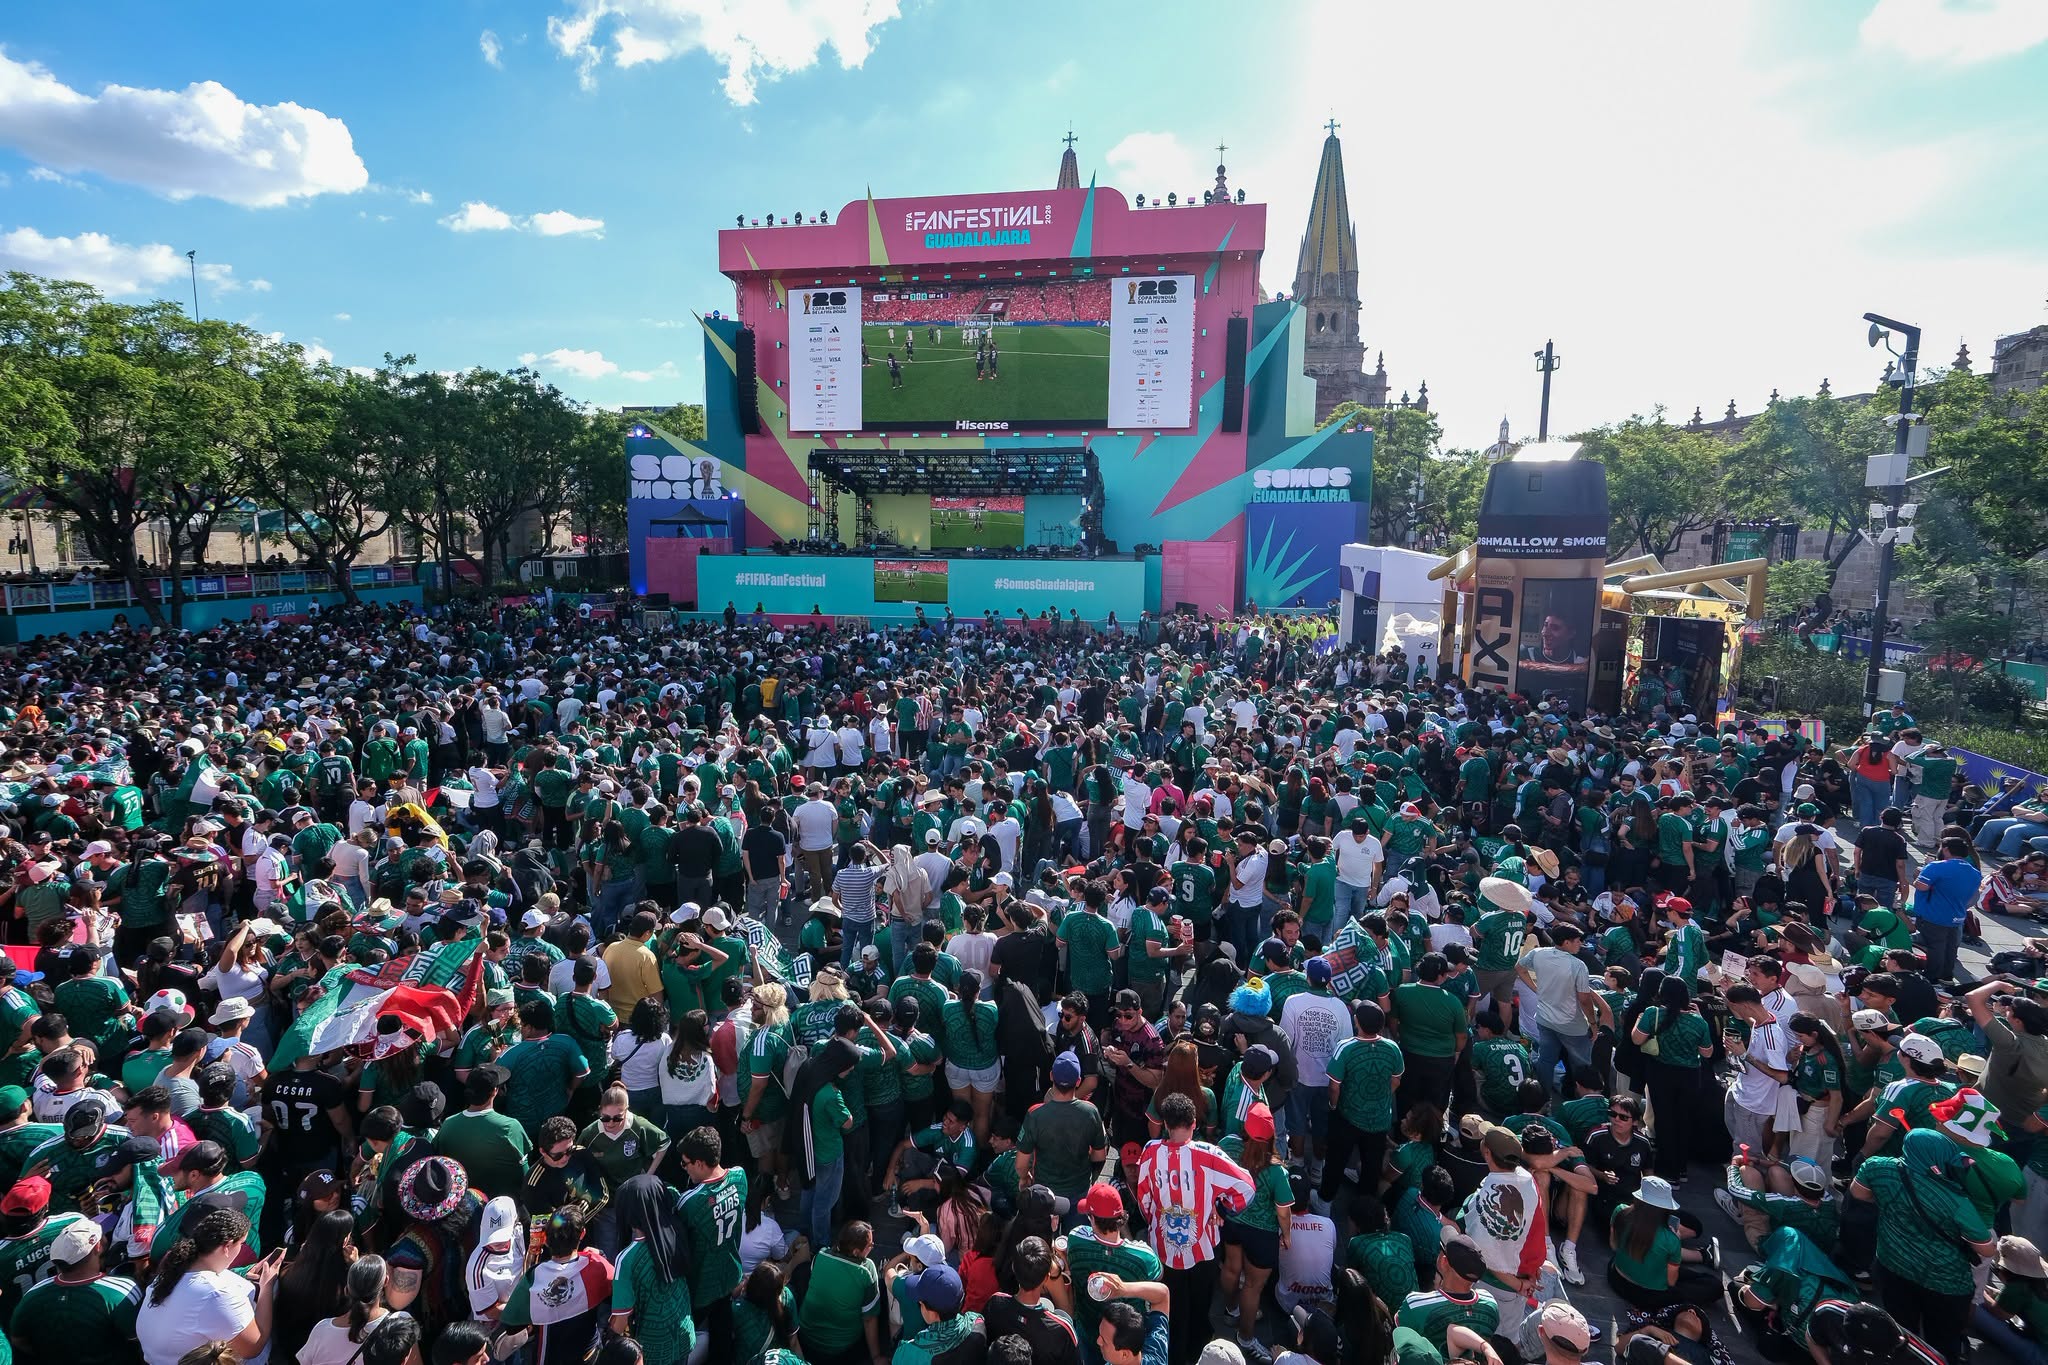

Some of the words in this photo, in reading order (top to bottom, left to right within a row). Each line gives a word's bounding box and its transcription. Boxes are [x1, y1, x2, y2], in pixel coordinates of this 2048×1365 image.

[905, 212, 913, 231] FIFA
[924, 229, 1031, 249] GUADALAJARA
[955, 420, 1009, 430] Hisense
[1253, 466, 1352, 488] SOMOS
[1252, 488, 1351, 503] GUADALAJARA
[1562, 536, 1606, 547] SMOKE
[735, 572, 826, 588] #FIFAFanFestival
[994, 577, 1095, 593] #SomosGuadalajara
[123, 794, 139, 815] 23
[1182, 880, 1195, 902] 9
[1503, 930, 1524, 957] 10
[1503, 1053, 1524, 1087] 3
[276, 1084, 312, 1096] CESAR
[271, 1100, 318, 1131] 07
[319, 1173, 333, 1184] LA
[1155, 1169, 1196, 1191] SPORT
[713, 1193, 740, 1219] ELIAS
[716, 1209, 737, 1246] 17
[15, 1245, 50, 1271] A.VEG
